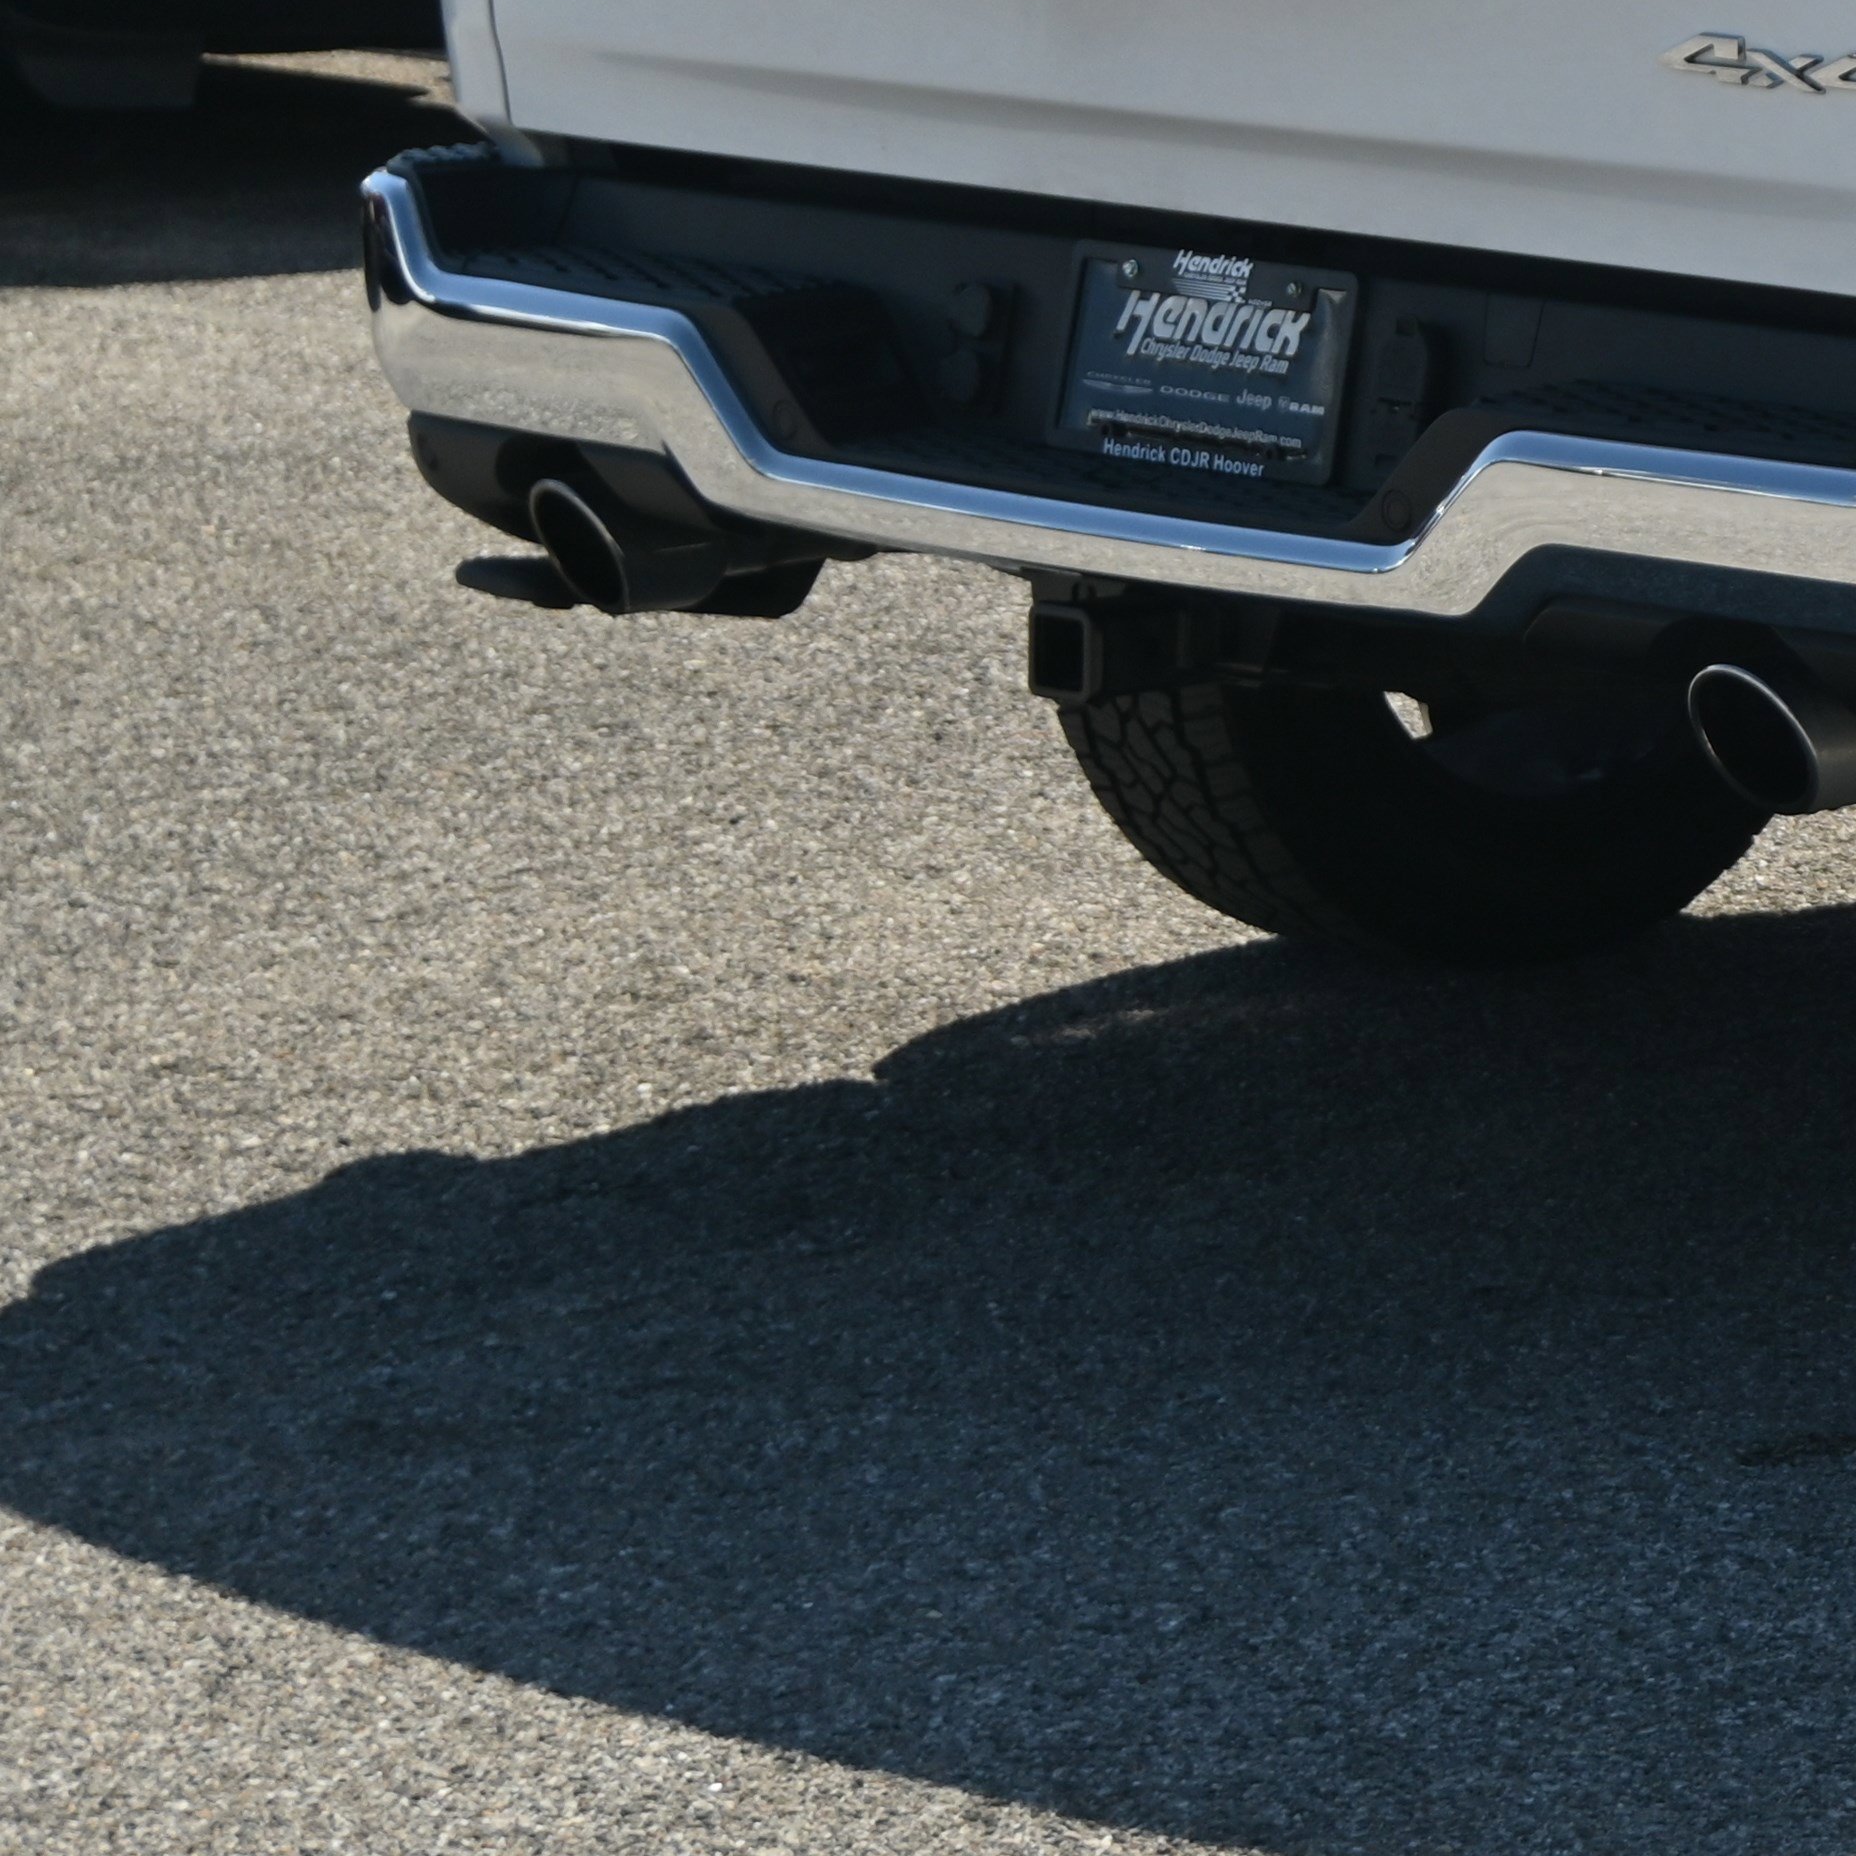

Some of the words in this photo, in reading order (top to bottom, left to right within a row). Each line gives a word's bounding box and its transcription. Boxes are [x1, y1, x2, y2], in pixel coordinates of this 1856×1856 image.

[1173, 249, 1254, 278] Hendrick
[1115, 290, 1312, 356] Hendrick
[1141, 337, 1190, 362] Chrysler
[1190, 345, 1230, 370] Dodge
[1229, 351, 1260, 373] Jeep
[1260, 354, 1289, 375] Ram
[1160, 385, 1229, 404] DODGE
[1236, 388, 1272, 410] Jeep
[1289, 401, 1325, 416] RAM
[1103, 437, 1166, 462] Hendrick
[1170, 446, 1209, 470] CDJR
[1214, 454, 1265, 477] Hoover
